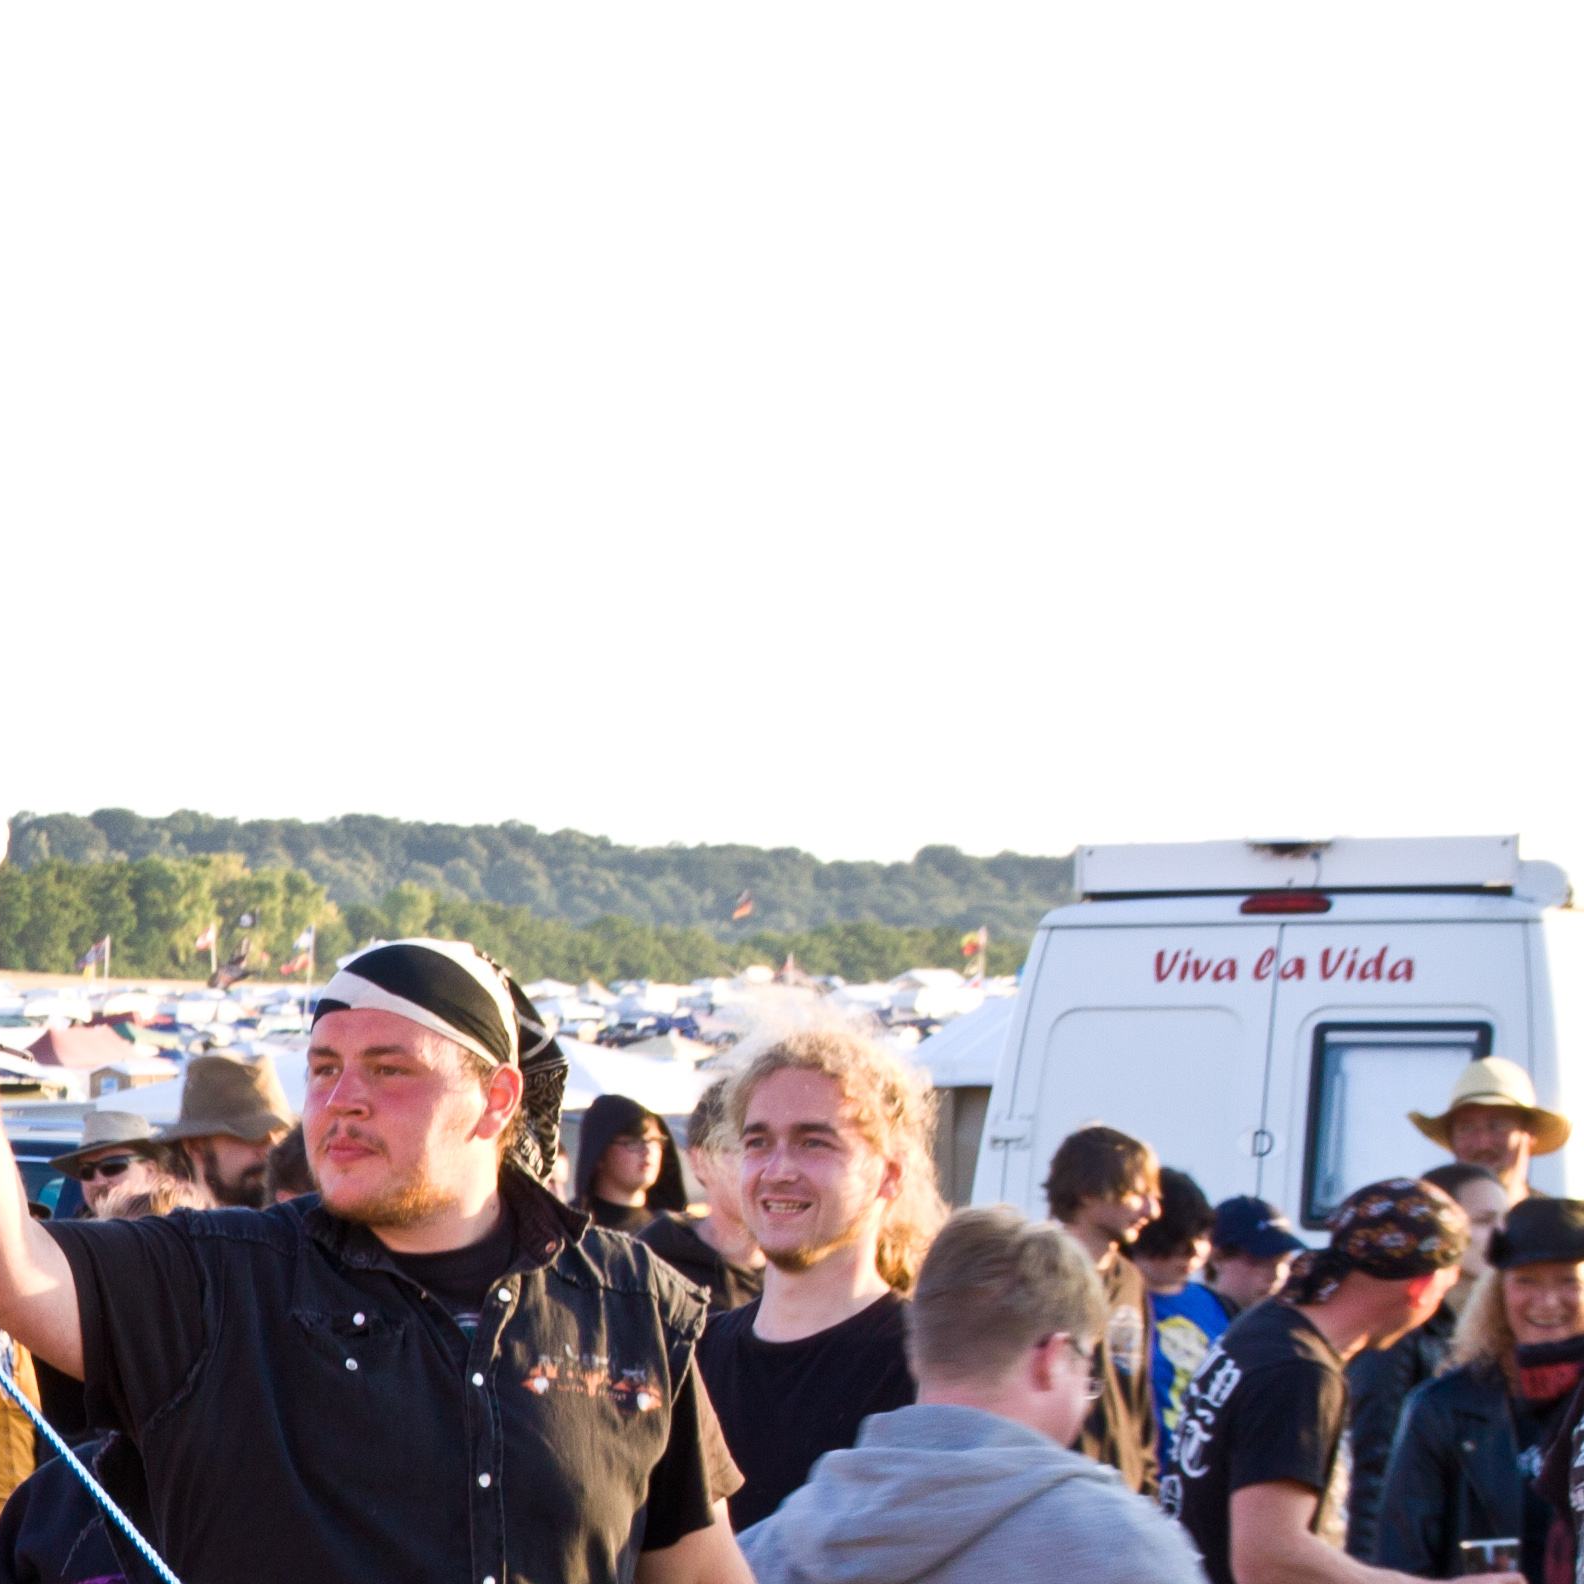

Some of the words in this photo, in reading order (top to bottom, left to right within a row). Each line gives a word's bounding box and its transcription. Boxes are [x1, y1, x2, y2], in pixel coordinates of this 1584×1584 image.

[1154, 948, 1237, 983] Viva
[1252, 946, 1306, 982] la
[1319, 945, 1415, 983] Vida
